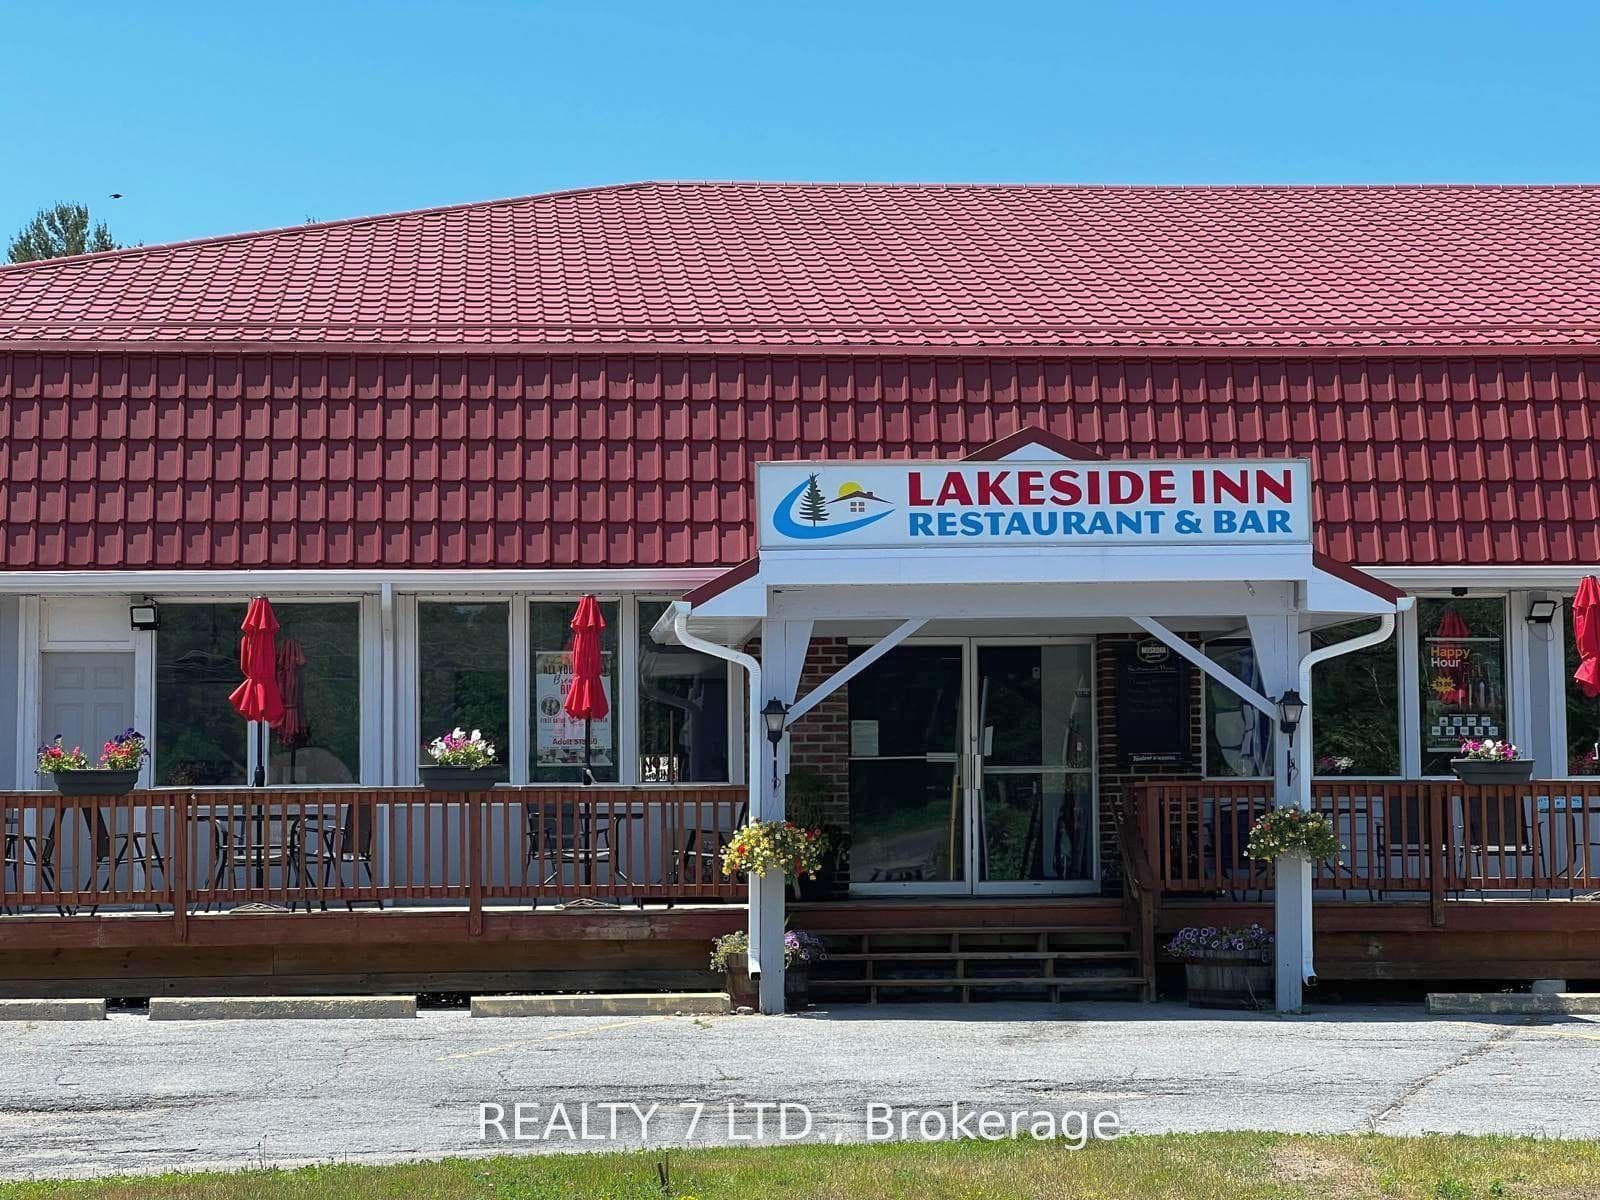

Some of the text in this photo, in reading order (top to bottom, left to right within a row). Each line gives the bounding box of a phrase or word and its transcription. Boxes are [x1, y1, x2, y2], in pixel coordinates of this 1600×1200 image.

[908, 469, 1292, 506] LAKESIDE INN
[909, 509, 1293, 537] RESTAURANT & BAR
[1431, 647, 1470, 658] Happy
[1431, 657, 1461, 667] Hour
[543, 665, 574, 675] ALL YOU
